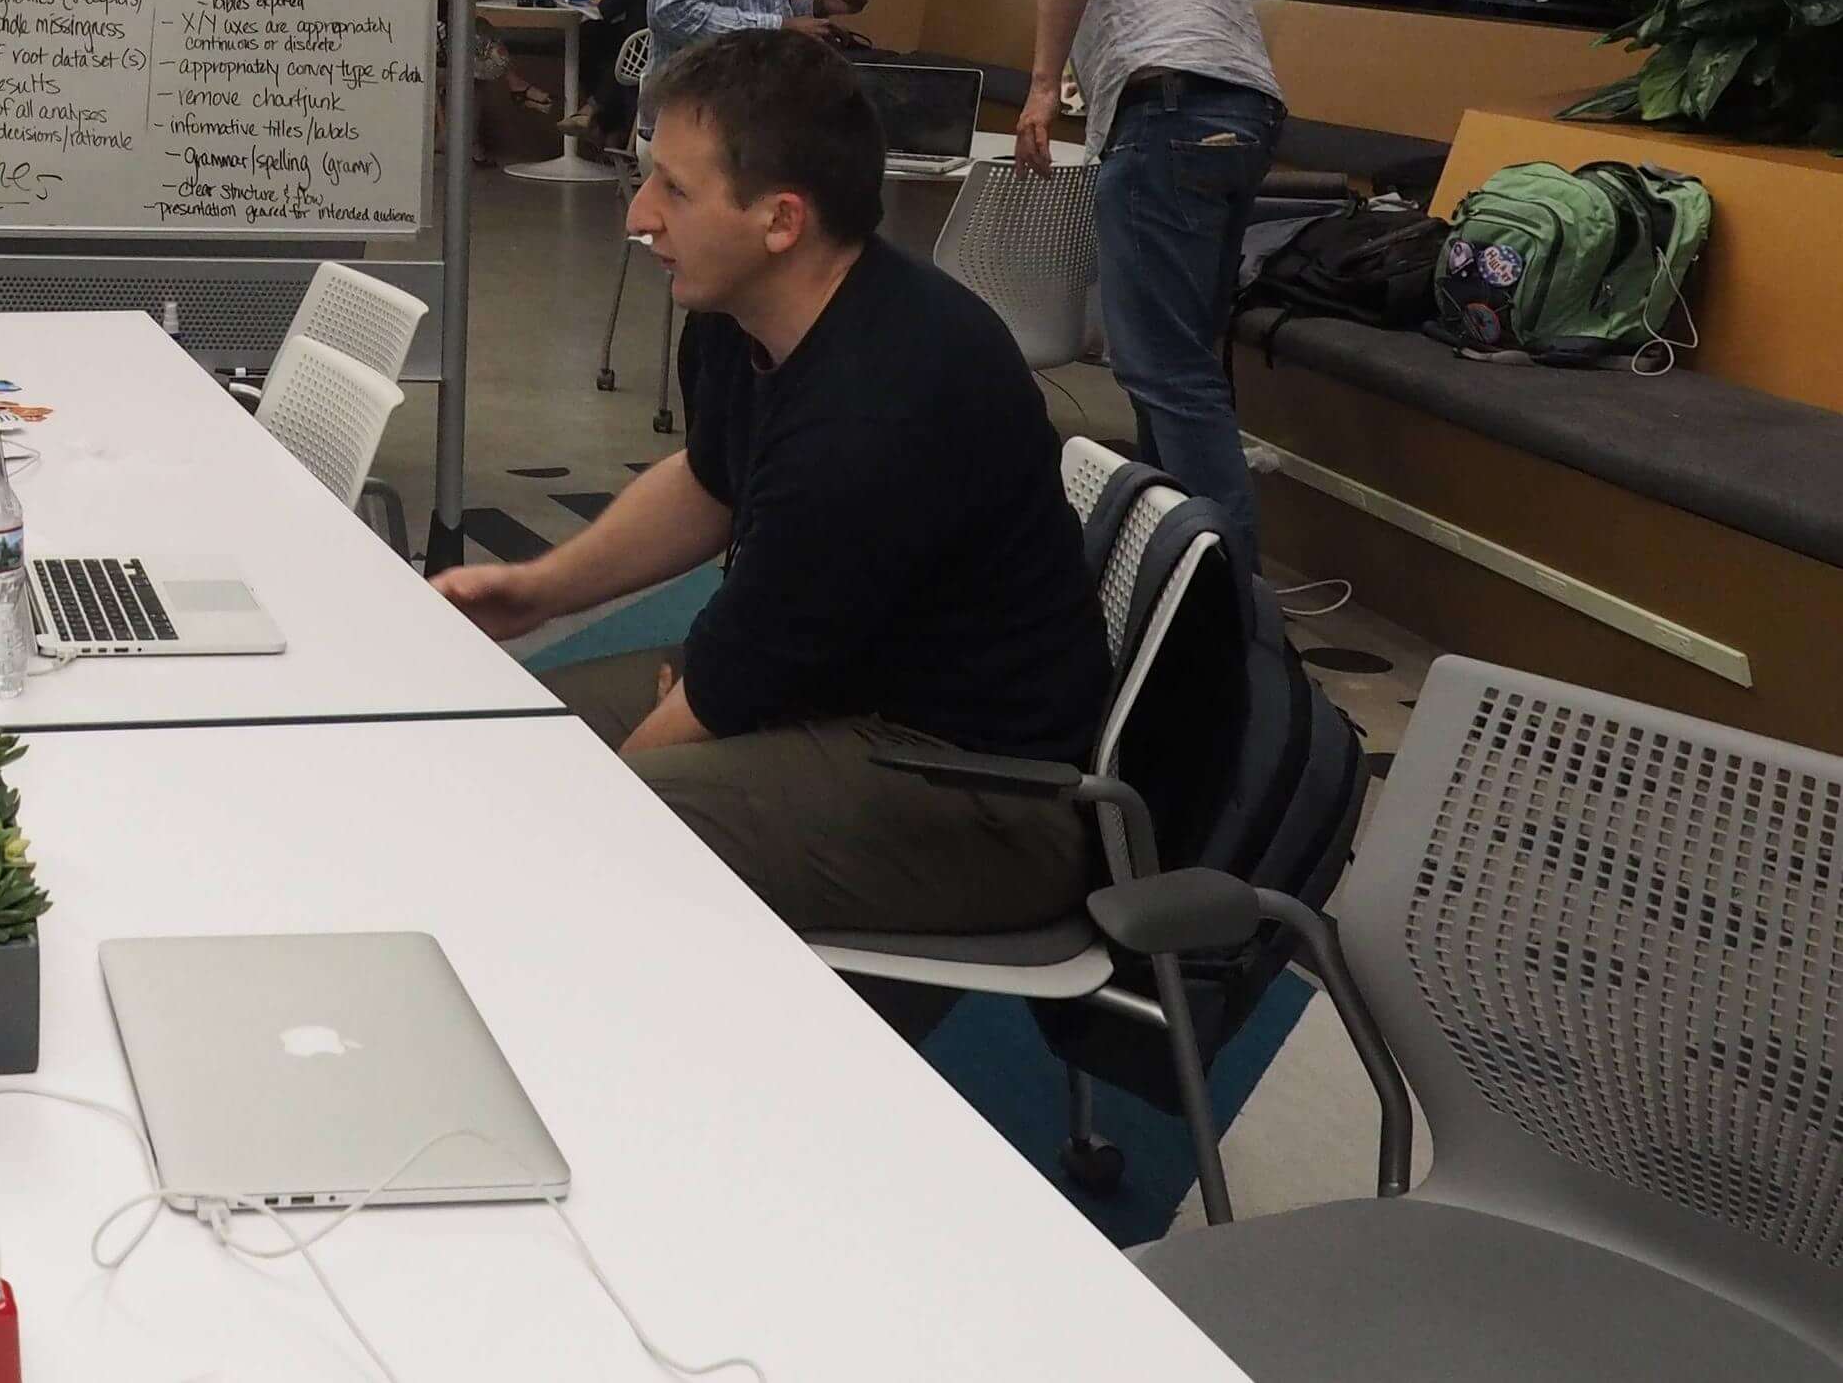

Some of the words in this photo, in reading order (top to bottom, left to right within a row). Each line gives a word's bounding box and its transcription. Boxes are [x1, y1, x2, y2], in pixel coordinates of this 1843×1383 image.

[36, 12, 125, 53] missingness
[224, 19, 259, 35] axes
[266, 19, 289, 34] are
[297, 17, 393, 44] appropriately
[13, 49, 49, 65] root
[185, 37, 259, 51] continuous
[264, 39, 278, 50] or
[284, 37, 342, 53] discrete
[179, 58, 279, 88] appropriately
[336, 64, 374, 90] type
[382, 61, 398, 82] of
[178, 90, 240, 107] remove
[253, 88, 345, 118] chartjunk
[16, 99, 33, 116] all
[39, 102, 107, 134] analyses
[170, 112, 258, 137] informative
[220, 183, 278, 202] structure
[155, 201, 236, 221] presentation
[246, 204, 287, 223] geared
[288, 202, 310, 219] for
[318, 204, 368, 222] intended
